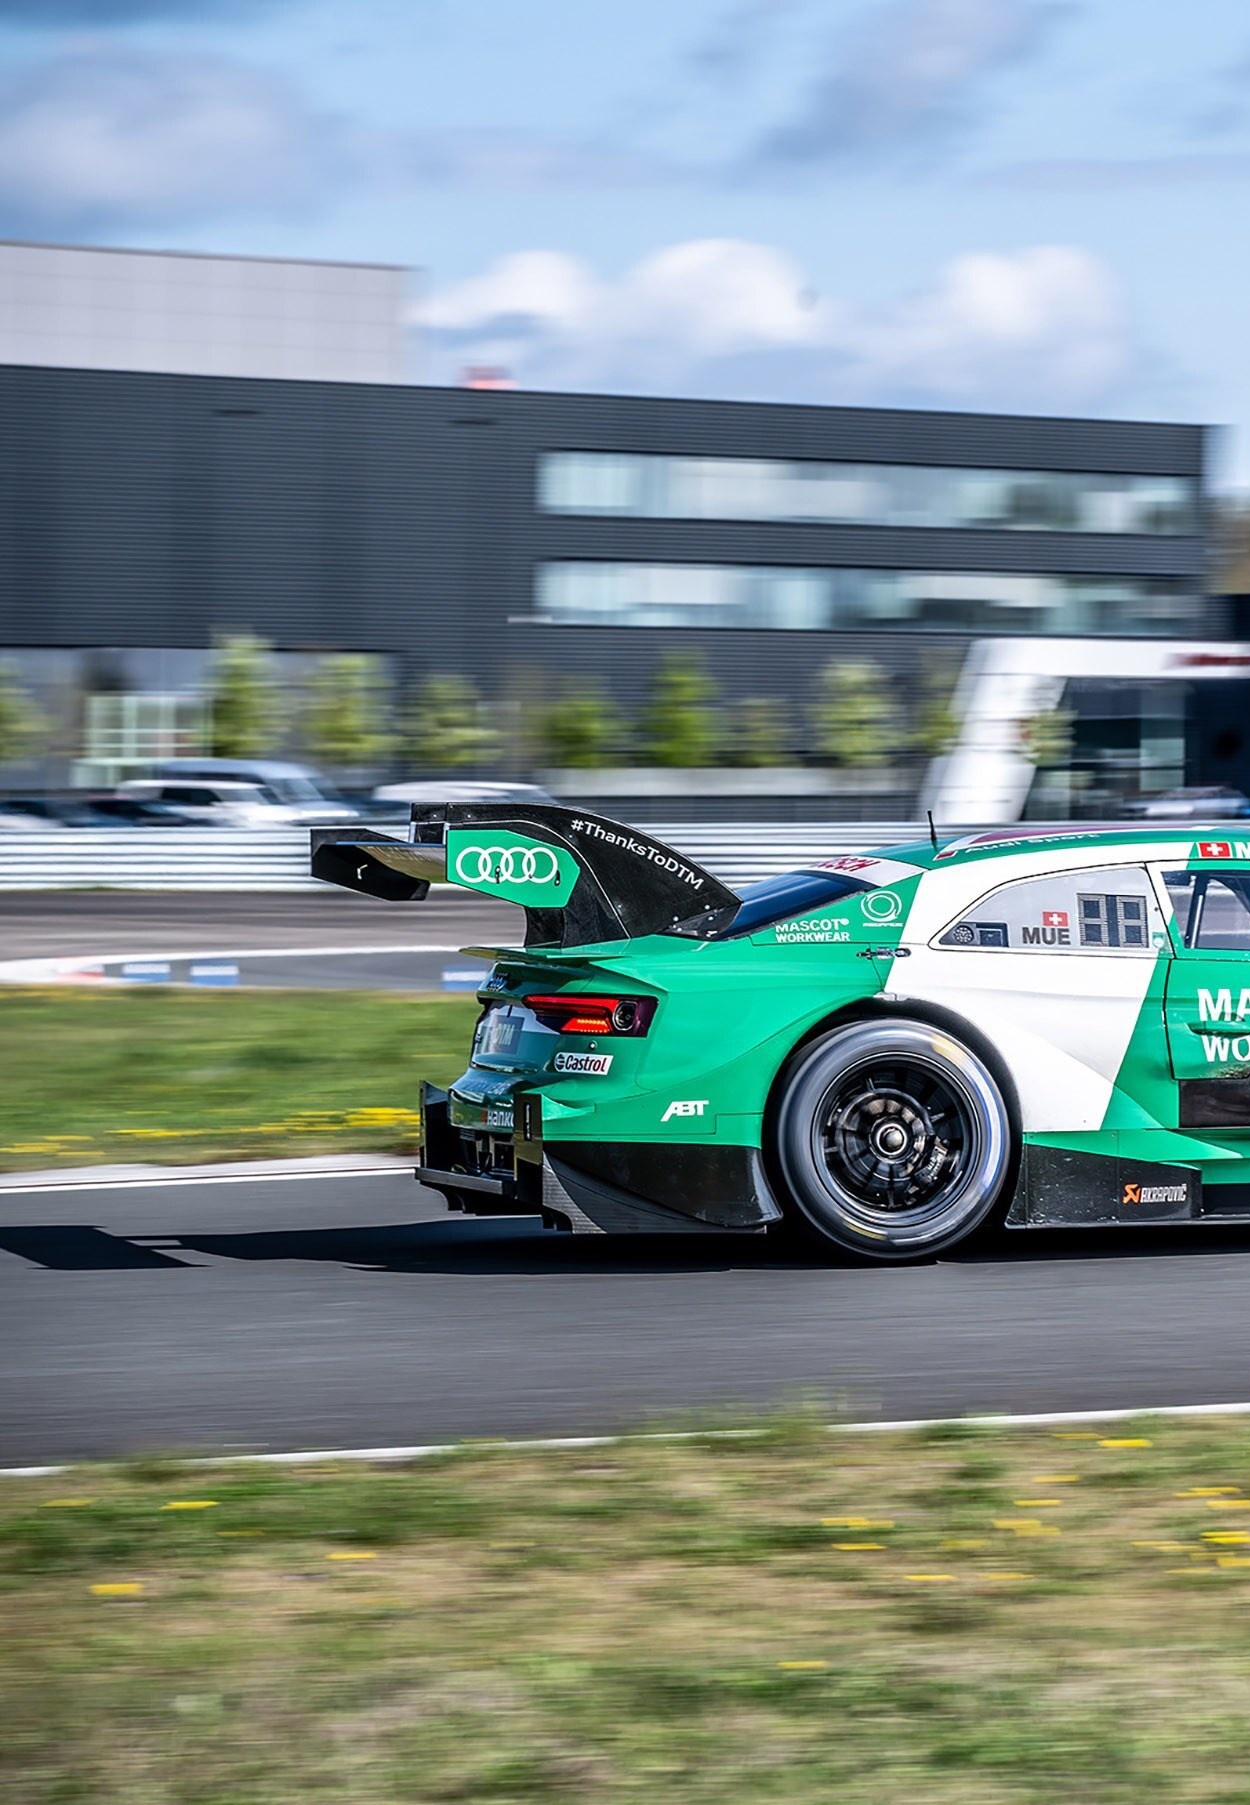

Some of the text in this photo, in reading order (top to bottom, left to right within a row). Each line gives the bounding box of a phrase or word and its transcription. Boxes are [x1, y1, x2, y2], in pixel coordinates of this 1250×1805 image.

[570, 818, 704, 890] #ThanksToDTM
[775, 930, 851, 943] WORKWEAR
[1022, 926, 1071, 946] MUE
[565, 1054, 608, 1074] Castrol
[660, 1100, 710, 1122] ABT
